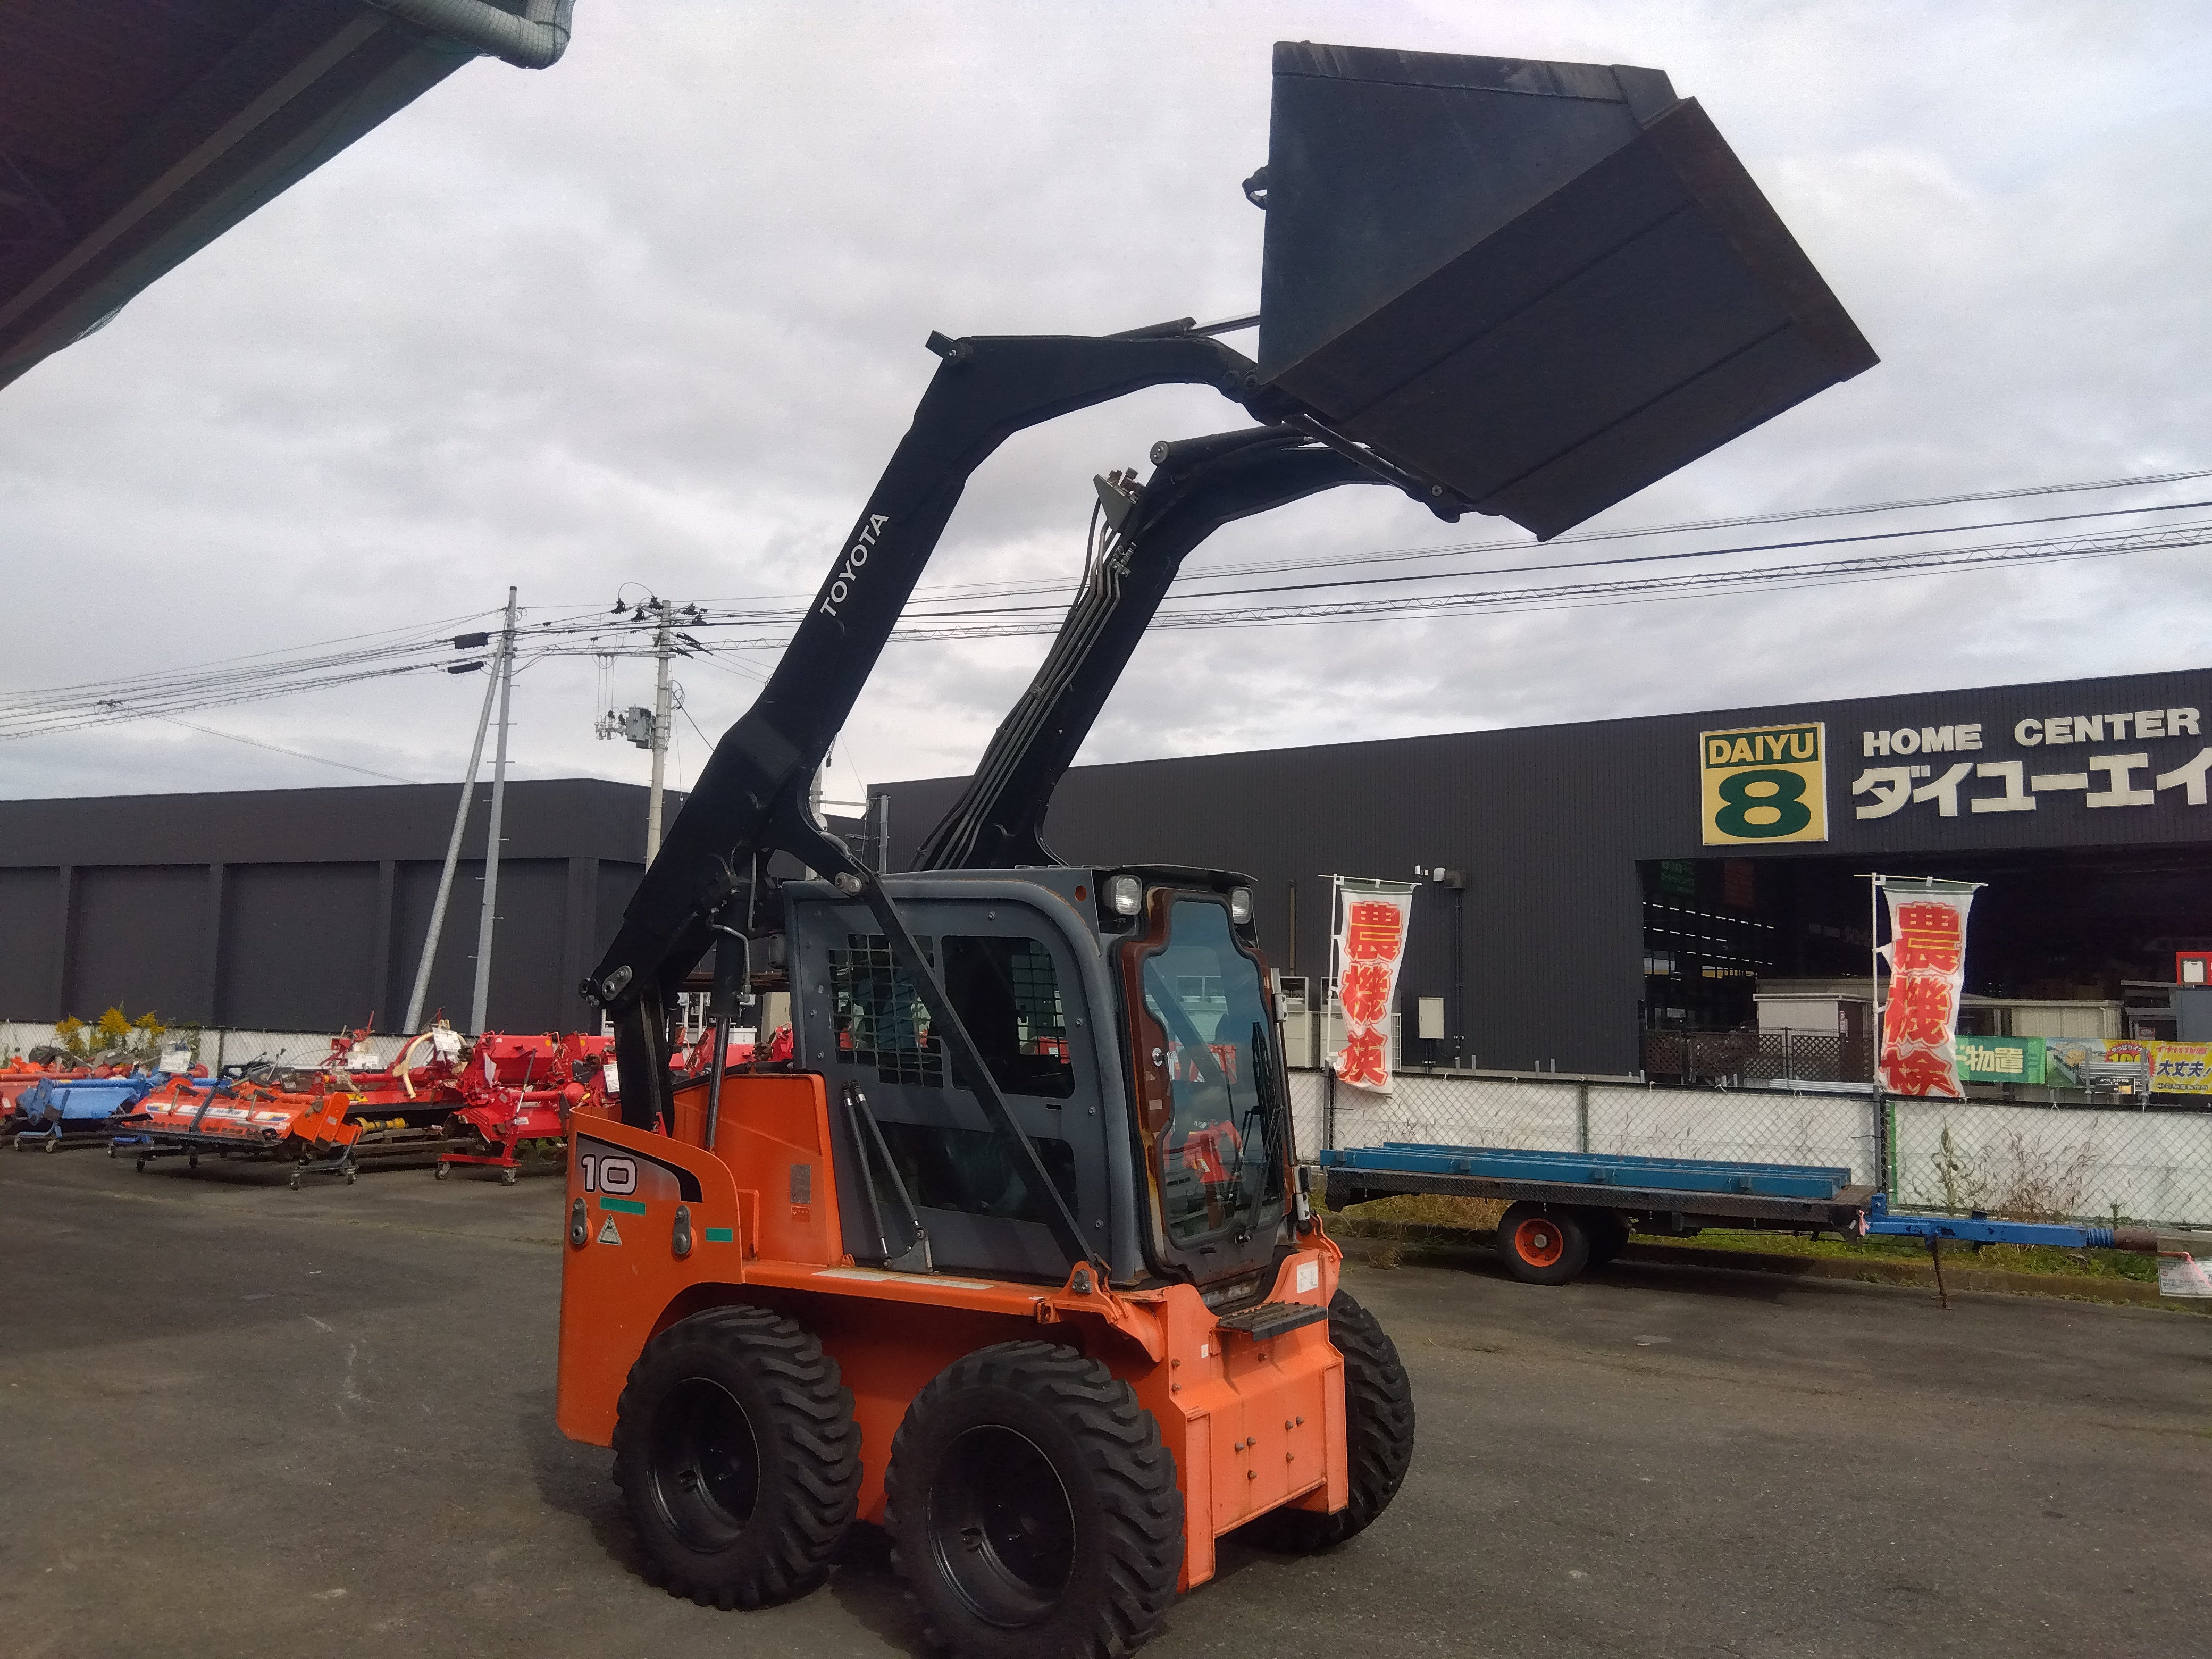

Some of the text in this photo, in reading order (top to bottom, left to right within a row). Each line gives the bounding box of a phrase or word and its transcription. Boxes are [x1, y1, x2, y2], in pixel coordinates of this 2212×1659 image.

[819, 514, 890, 617] TOYOTA
[1708, 732, 1815, 764] DAIYU
[1863, 707, 2202, 757] HOME CENTER
[1715, 769, 1812, 839] 8
[1852, 747, 2212, 819] ダイユーエイ
[581, 1153, 638, 1196] 10
